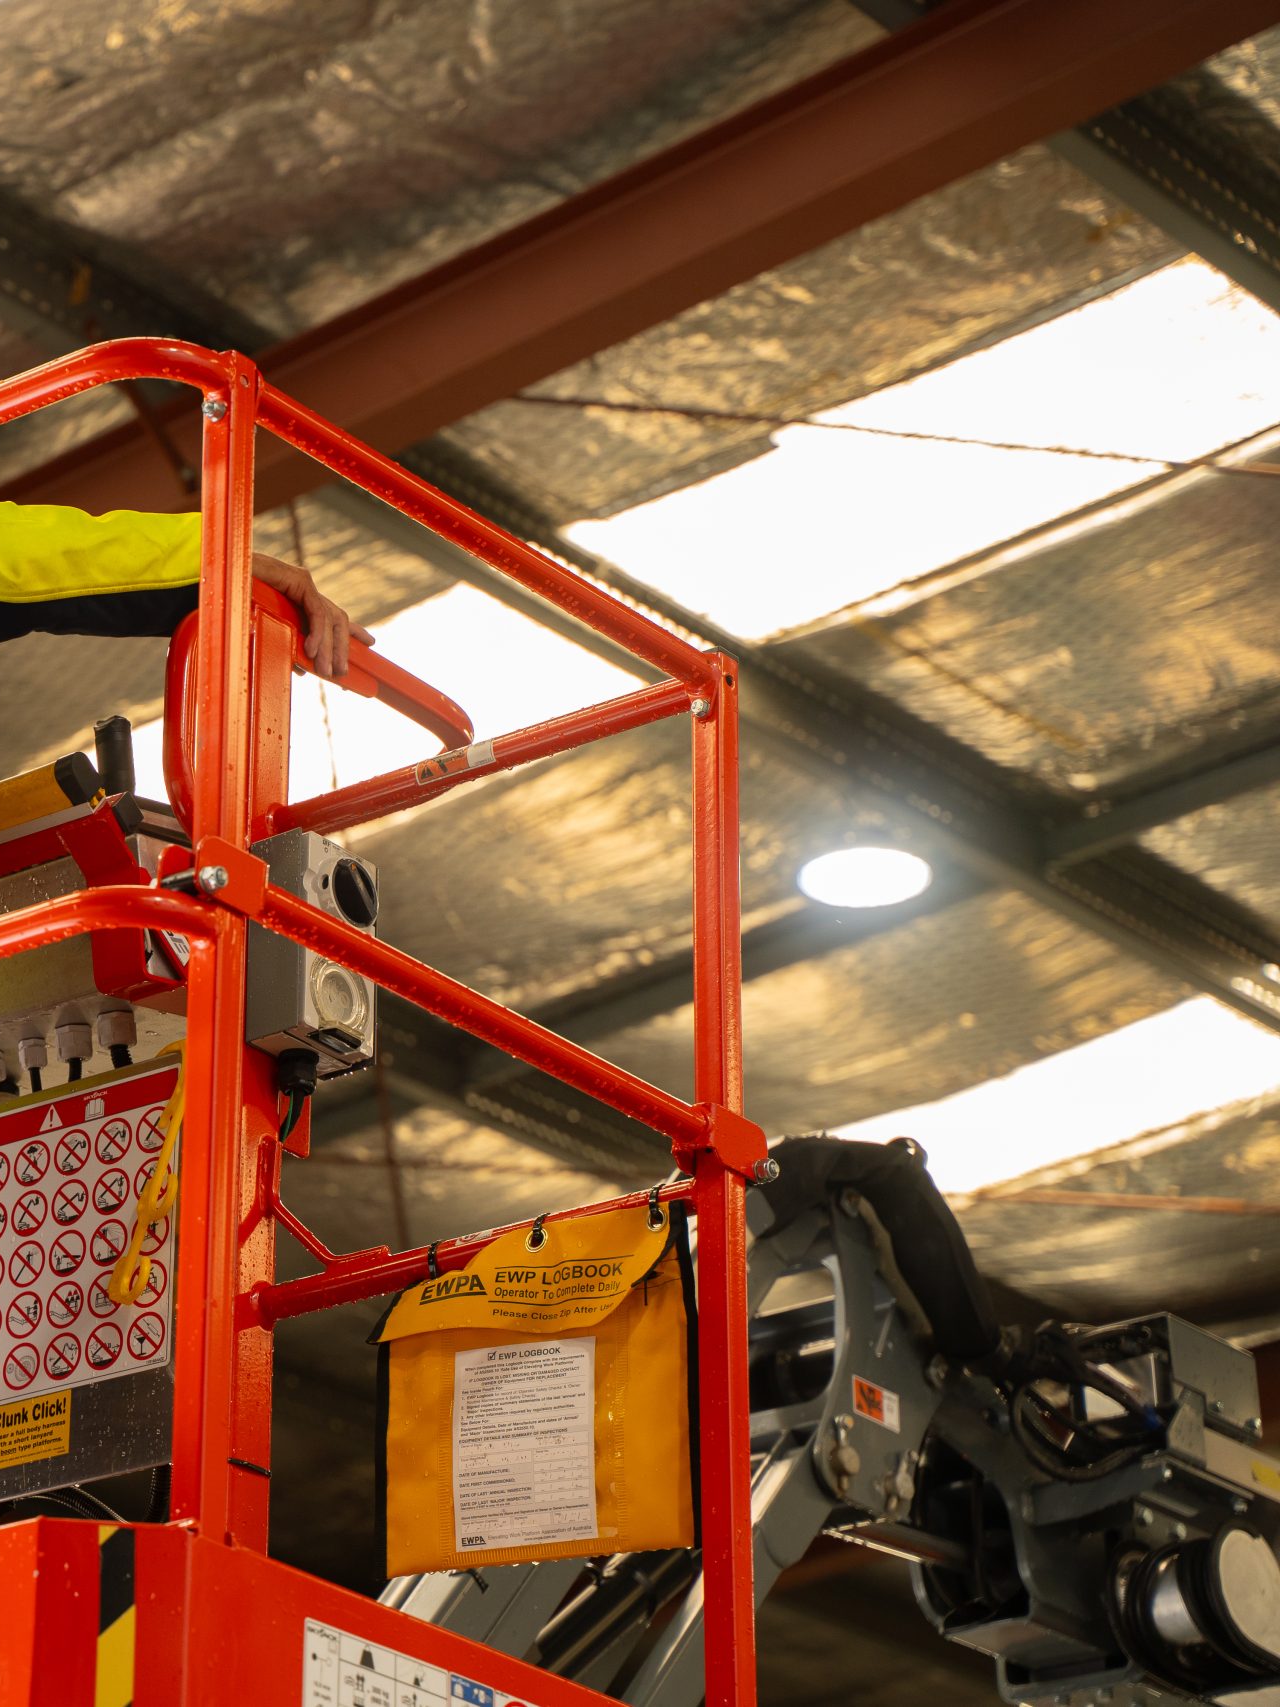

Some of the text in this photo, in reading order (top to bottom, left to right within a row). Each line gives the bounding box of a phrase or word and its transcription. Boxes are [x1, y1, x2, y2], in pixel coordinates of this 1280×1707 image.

[495, 1262, 624, 1285] EWP LOGBOOK
[421, 1275, 485, 1301] EWPA
[494, 1280, 621, 1300] Operator To Complete Daily
[492, 1308, 528, 1319] Please
[531, 1311, 558, 1320] Close
[559, 1308, 571, 1318] Zip
[573, 1305, 598, 1315] After
[499, 1347, 560, 1360] EWP LOGBOOK
[32, 1397, 66, 1421] Click!
[16, 1428, 25, 1436] full
[27, 1426, 41, 1434] body
[42, 1420, 65, 1430] harness
[14, 1436, 29, 1444] short
[31, 1430, 53, 1440] lanyard
[19, 1443, 31, 1451] type
[541, 1527, 566, 1535] Association
[462, 1536, 485, 1545] EWPA
